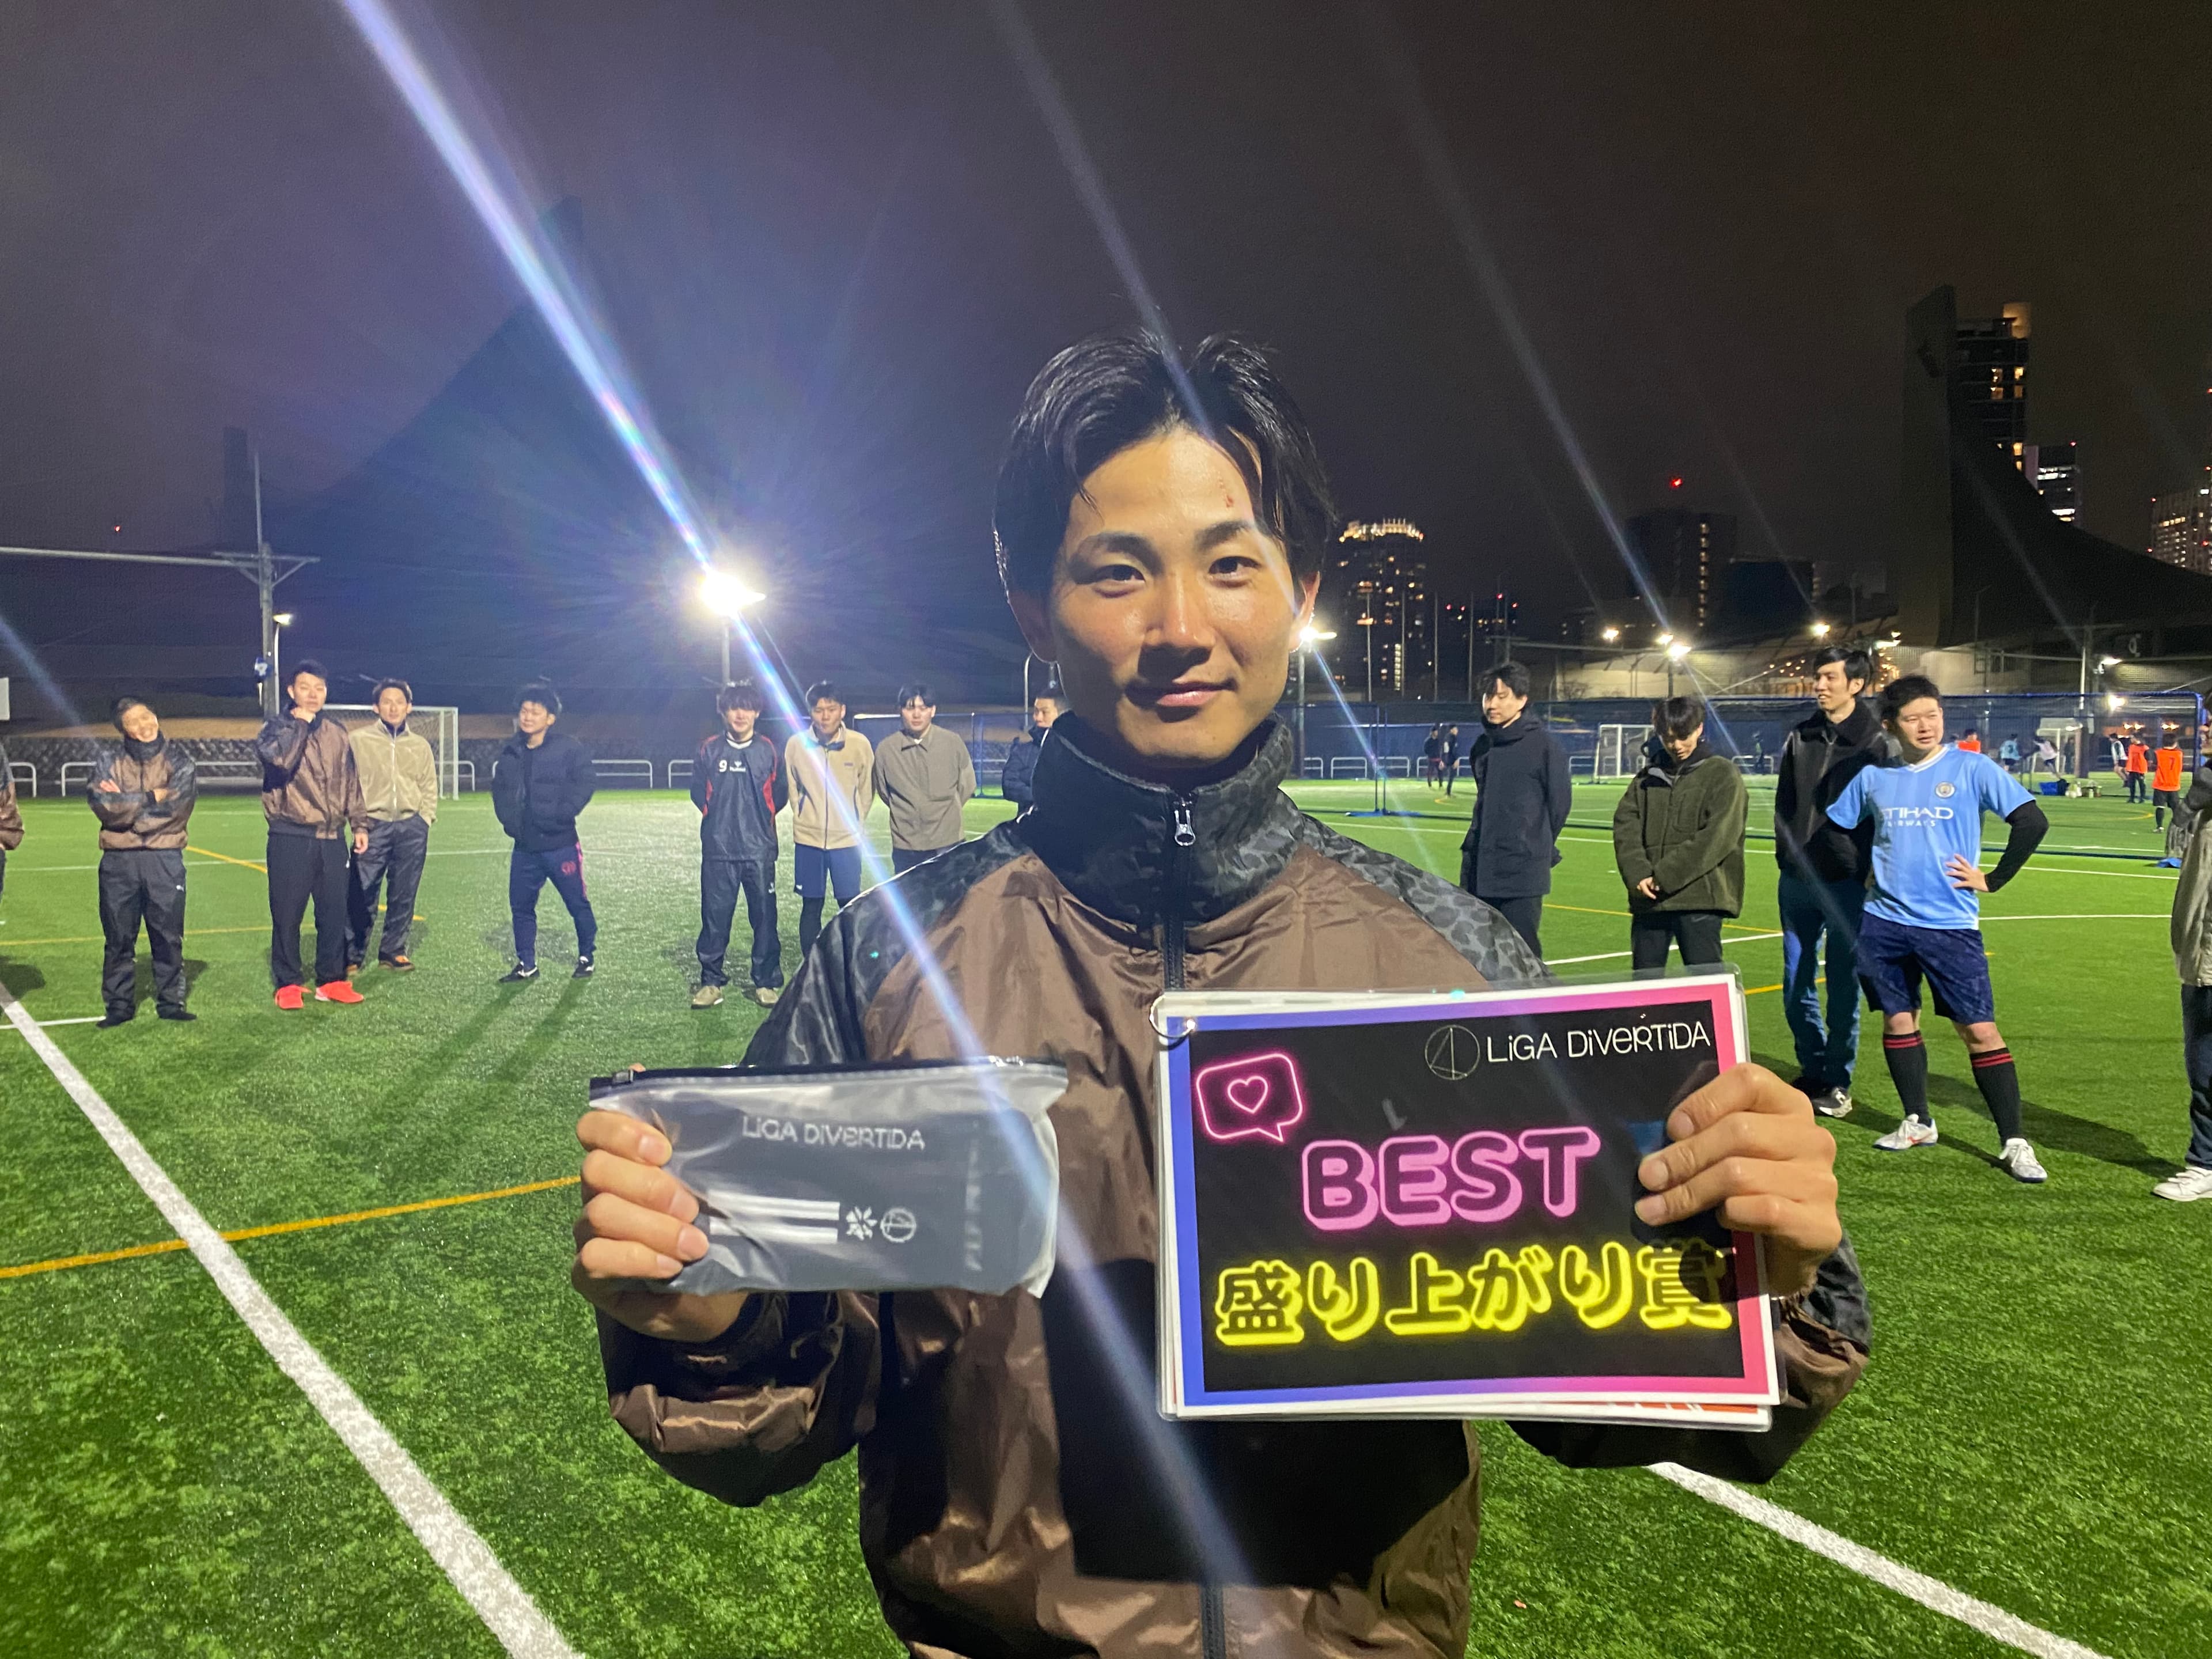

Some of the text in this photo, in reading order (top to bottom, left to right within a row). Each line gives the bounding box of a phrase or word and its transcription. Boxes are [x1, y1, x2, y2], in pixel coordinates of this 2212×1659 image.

[719, 759, 728, 772] 9
[1881, 806, 1955, 820] TIHAD
[1302, 1126, 1601, 1231] BEST
